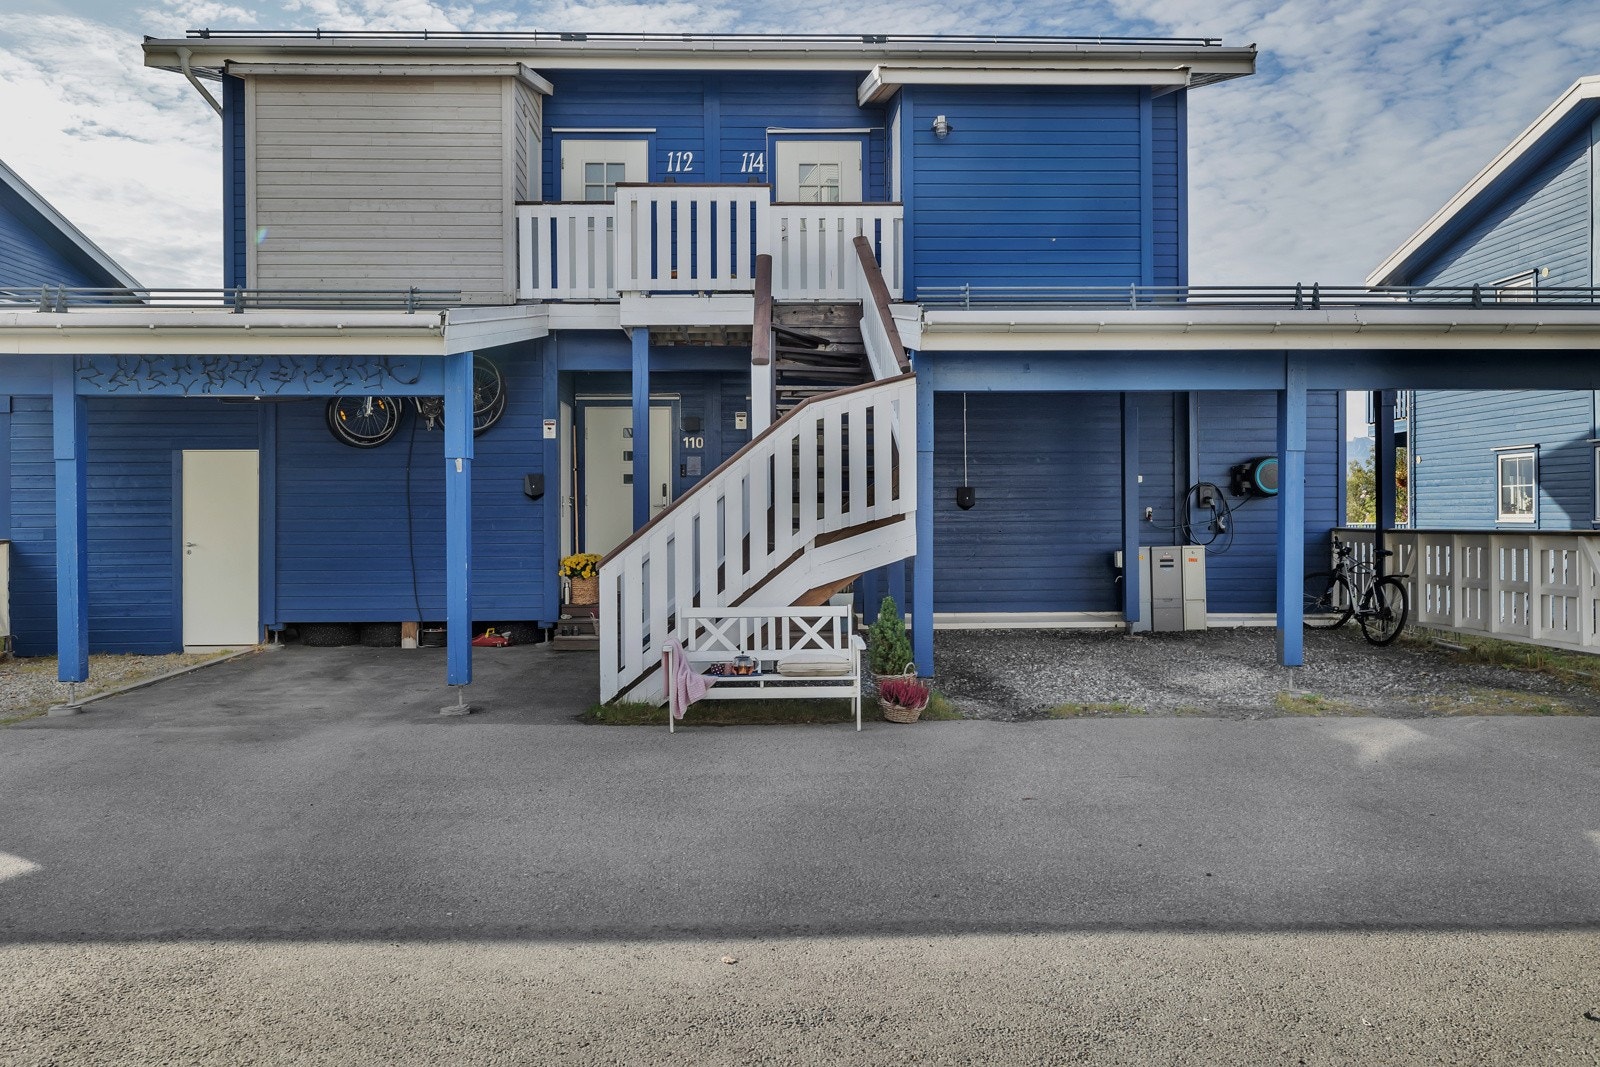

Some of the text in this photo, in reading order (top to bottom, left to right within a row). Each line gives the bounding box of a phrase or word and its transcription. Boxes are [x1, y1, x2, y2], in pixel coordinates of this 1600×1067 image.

[667, 151, 693, 172] 112
[740, 152, 764, 172] 114
[683, 436, 704, 449] 110
